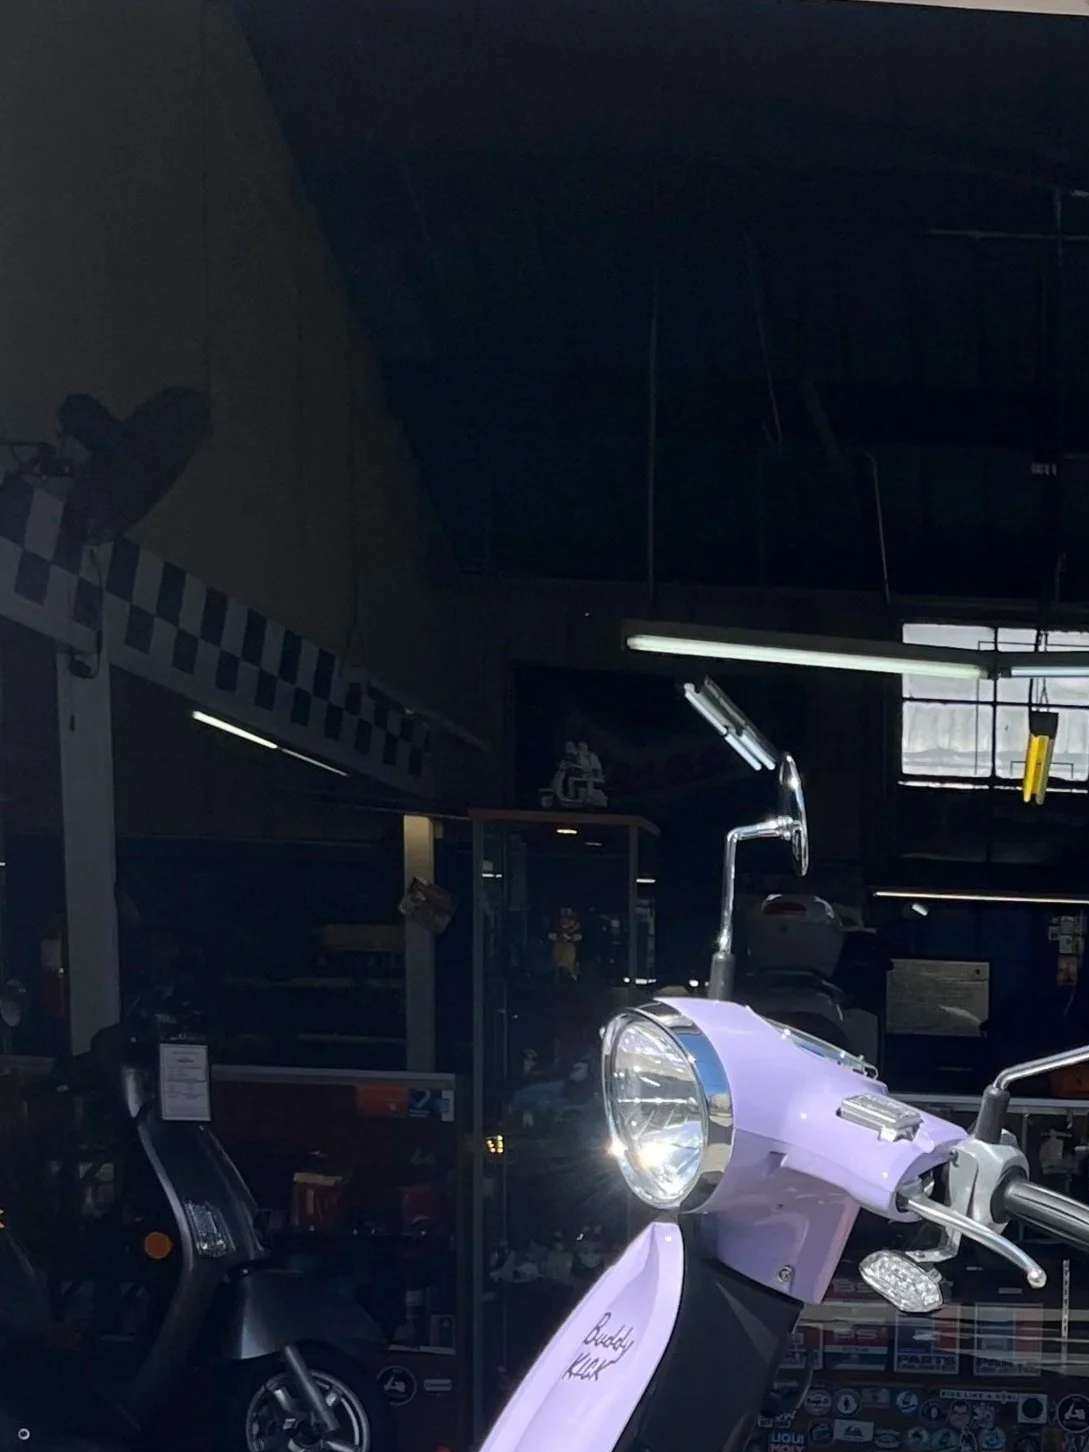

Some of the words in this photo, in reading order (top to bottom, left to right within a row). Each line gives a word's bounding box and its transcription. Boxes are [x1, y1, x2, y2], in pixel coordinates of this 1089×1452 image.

[583, 1311, 635, 1363] Buddy
[561, 1352, 613, 1381] KICK
[898, 1355, 956, 1366] PARTS
[771, 1432, 804, 1444] LIQUI
